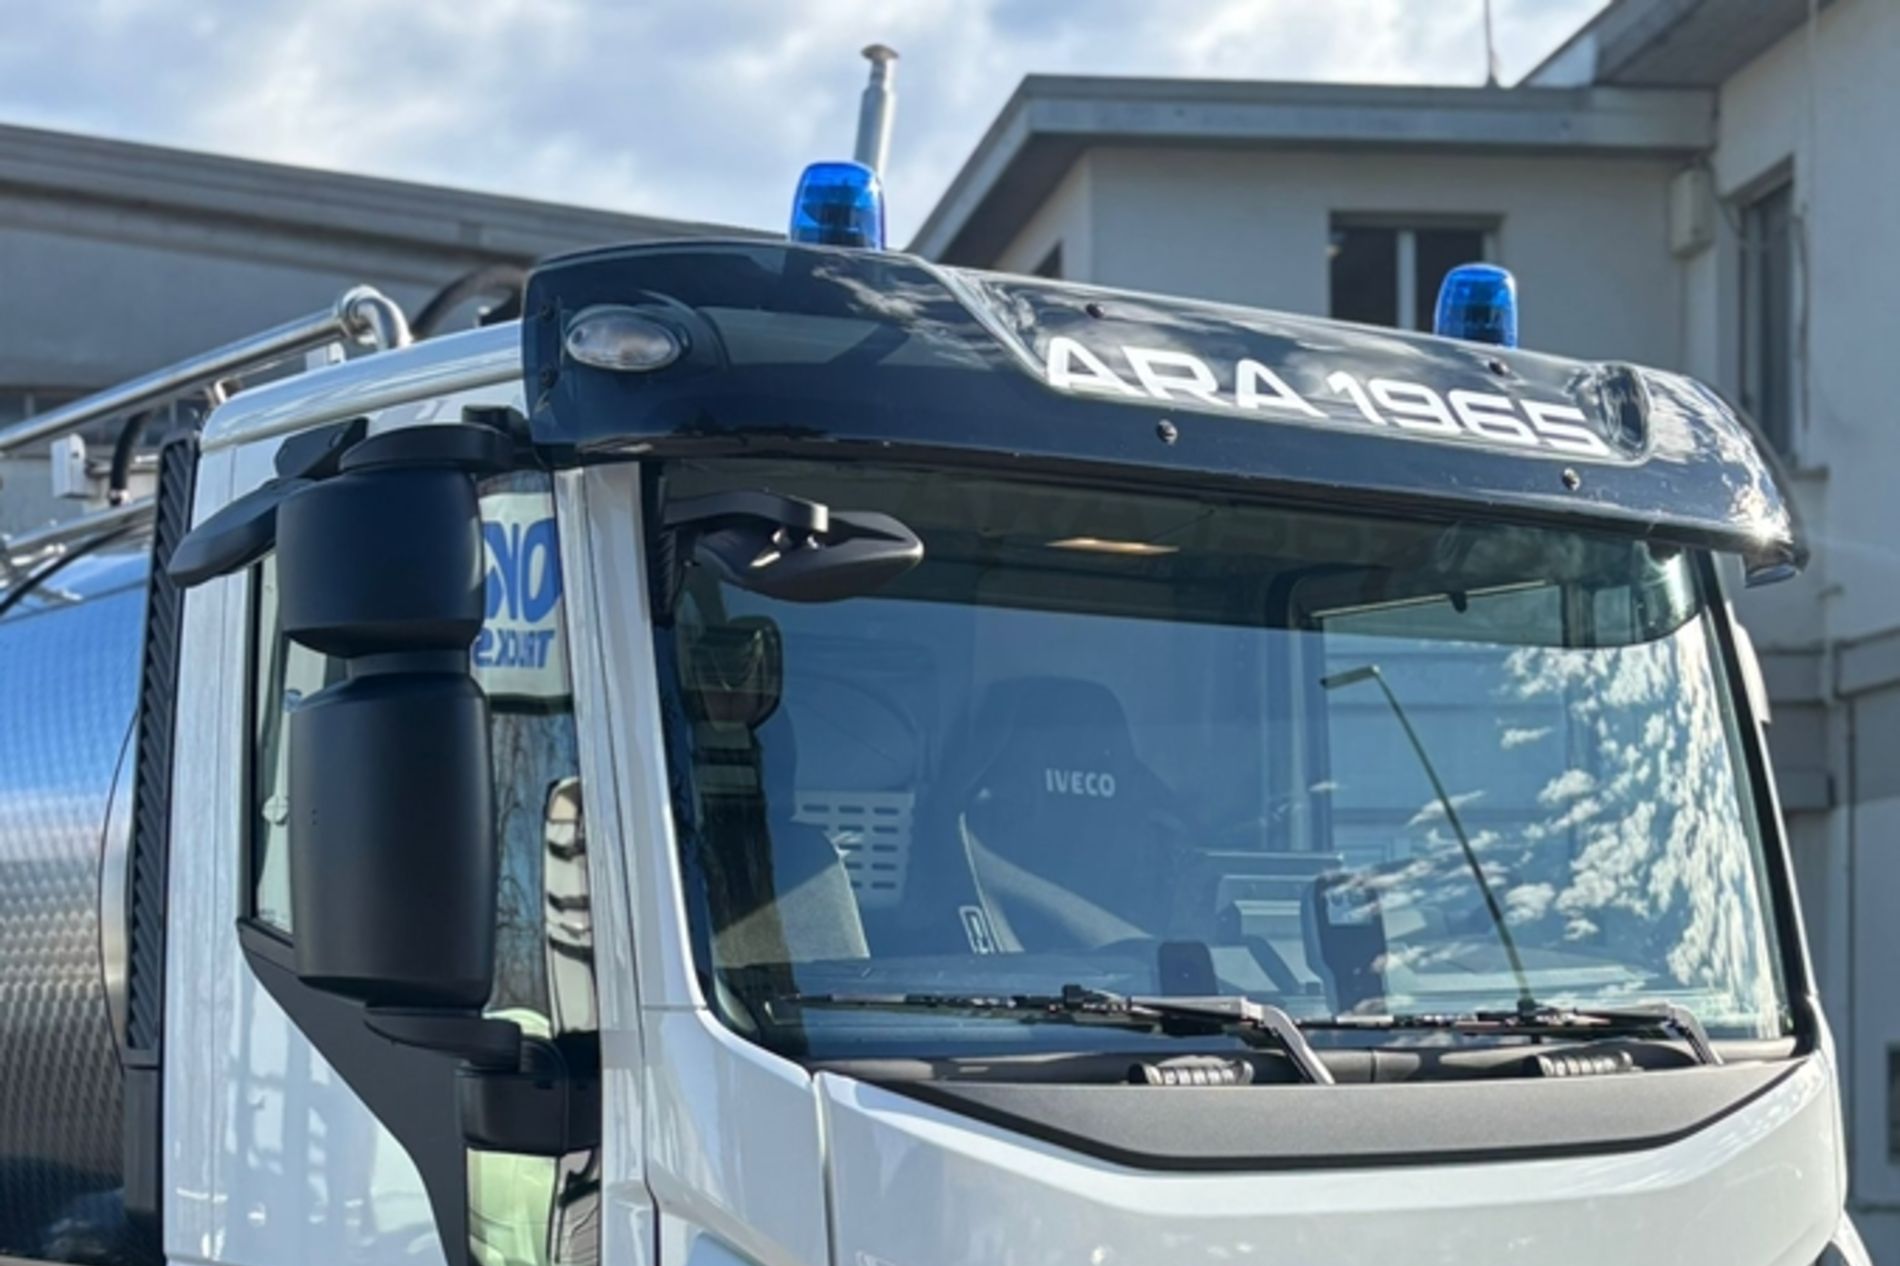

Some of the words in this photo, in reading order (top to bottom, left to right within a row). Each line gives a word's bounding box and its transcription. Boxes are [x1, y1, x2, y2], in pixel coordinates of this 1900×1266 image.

[1047, 336, 1328, 418] ARA
[1326, 371, 1612, 456] 1965
[1046, 768, 1116, 797] IVECO
